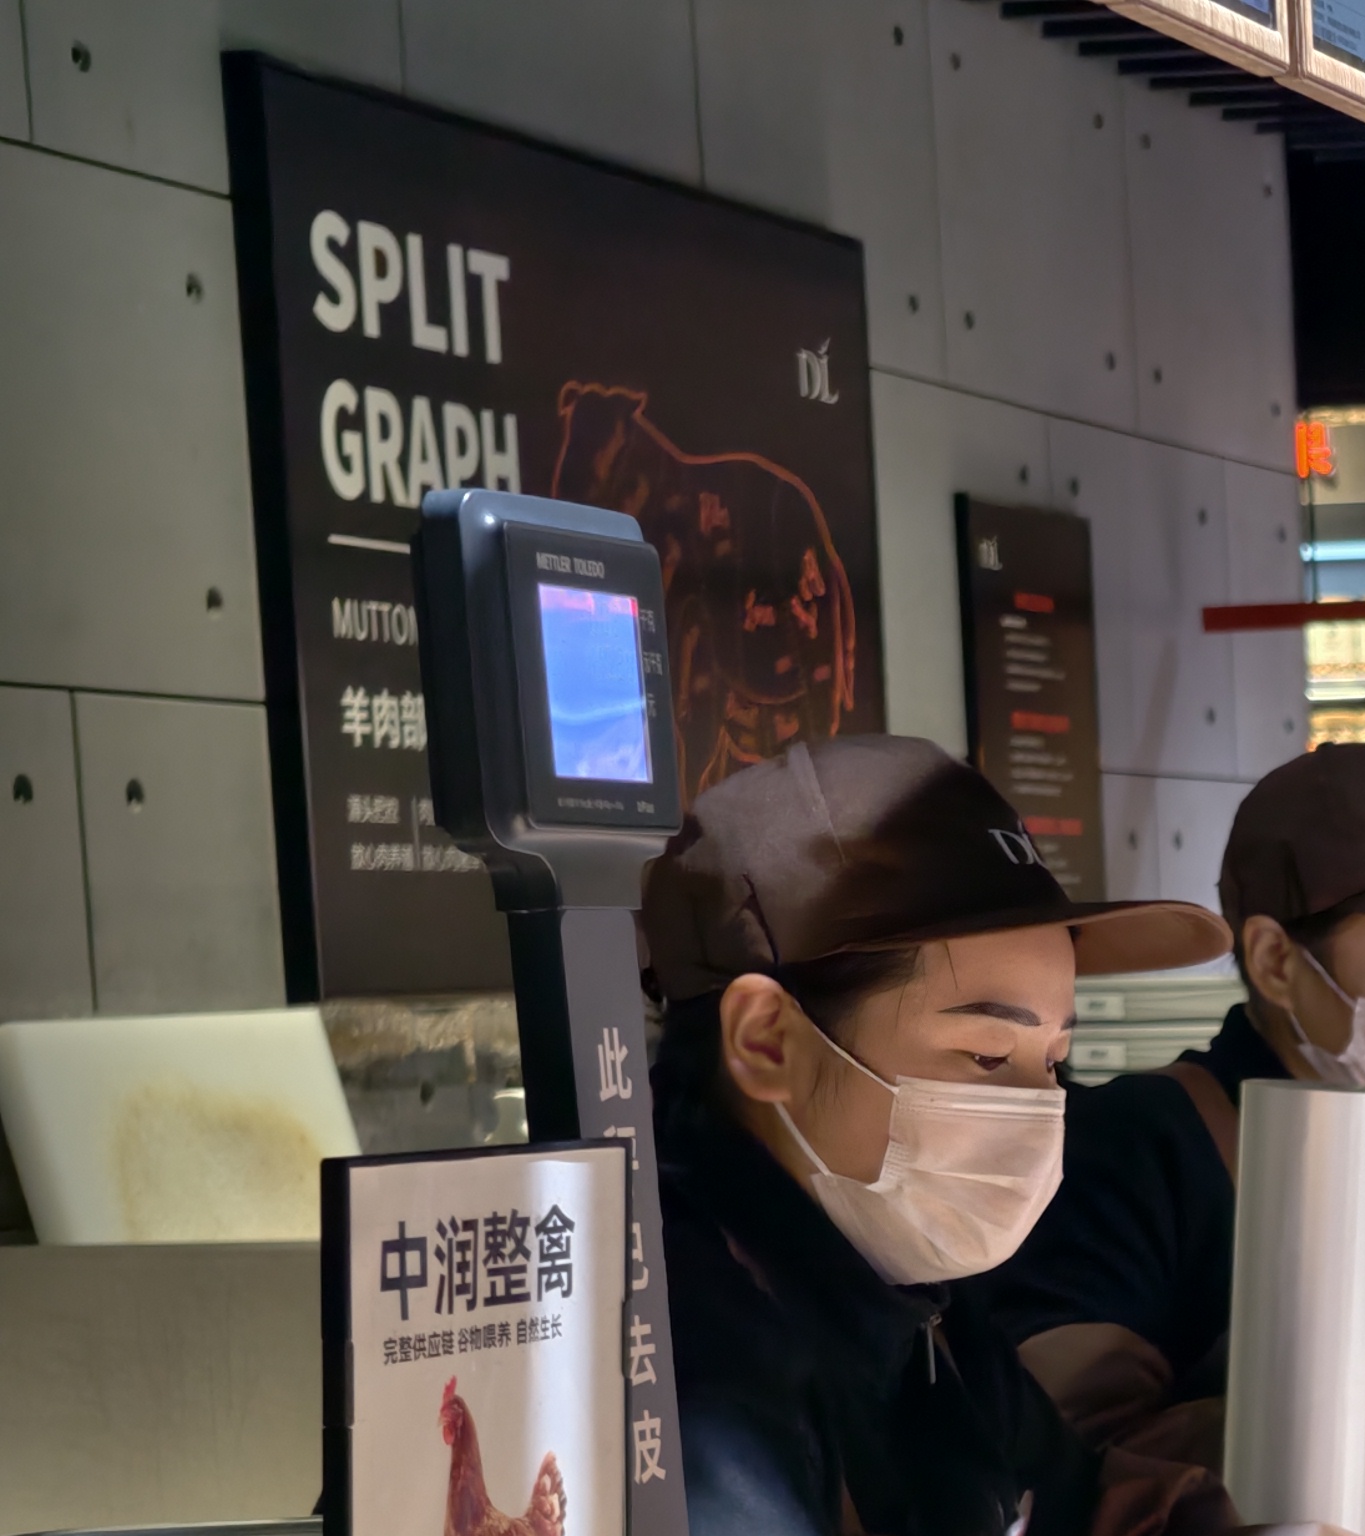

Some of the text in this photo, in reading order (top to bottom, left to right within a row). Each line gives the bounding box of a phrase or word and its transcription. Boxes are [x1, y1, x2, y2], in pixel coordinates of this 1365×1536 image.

[308, 206, 511, 366] SPLIT
[320, 376, 522, 510] GRAPH
[378, 1203, 577, 1322] 中润整禽
[381, 1312, 564, 1367] 完整供应链 谷物喂养 自然生长
